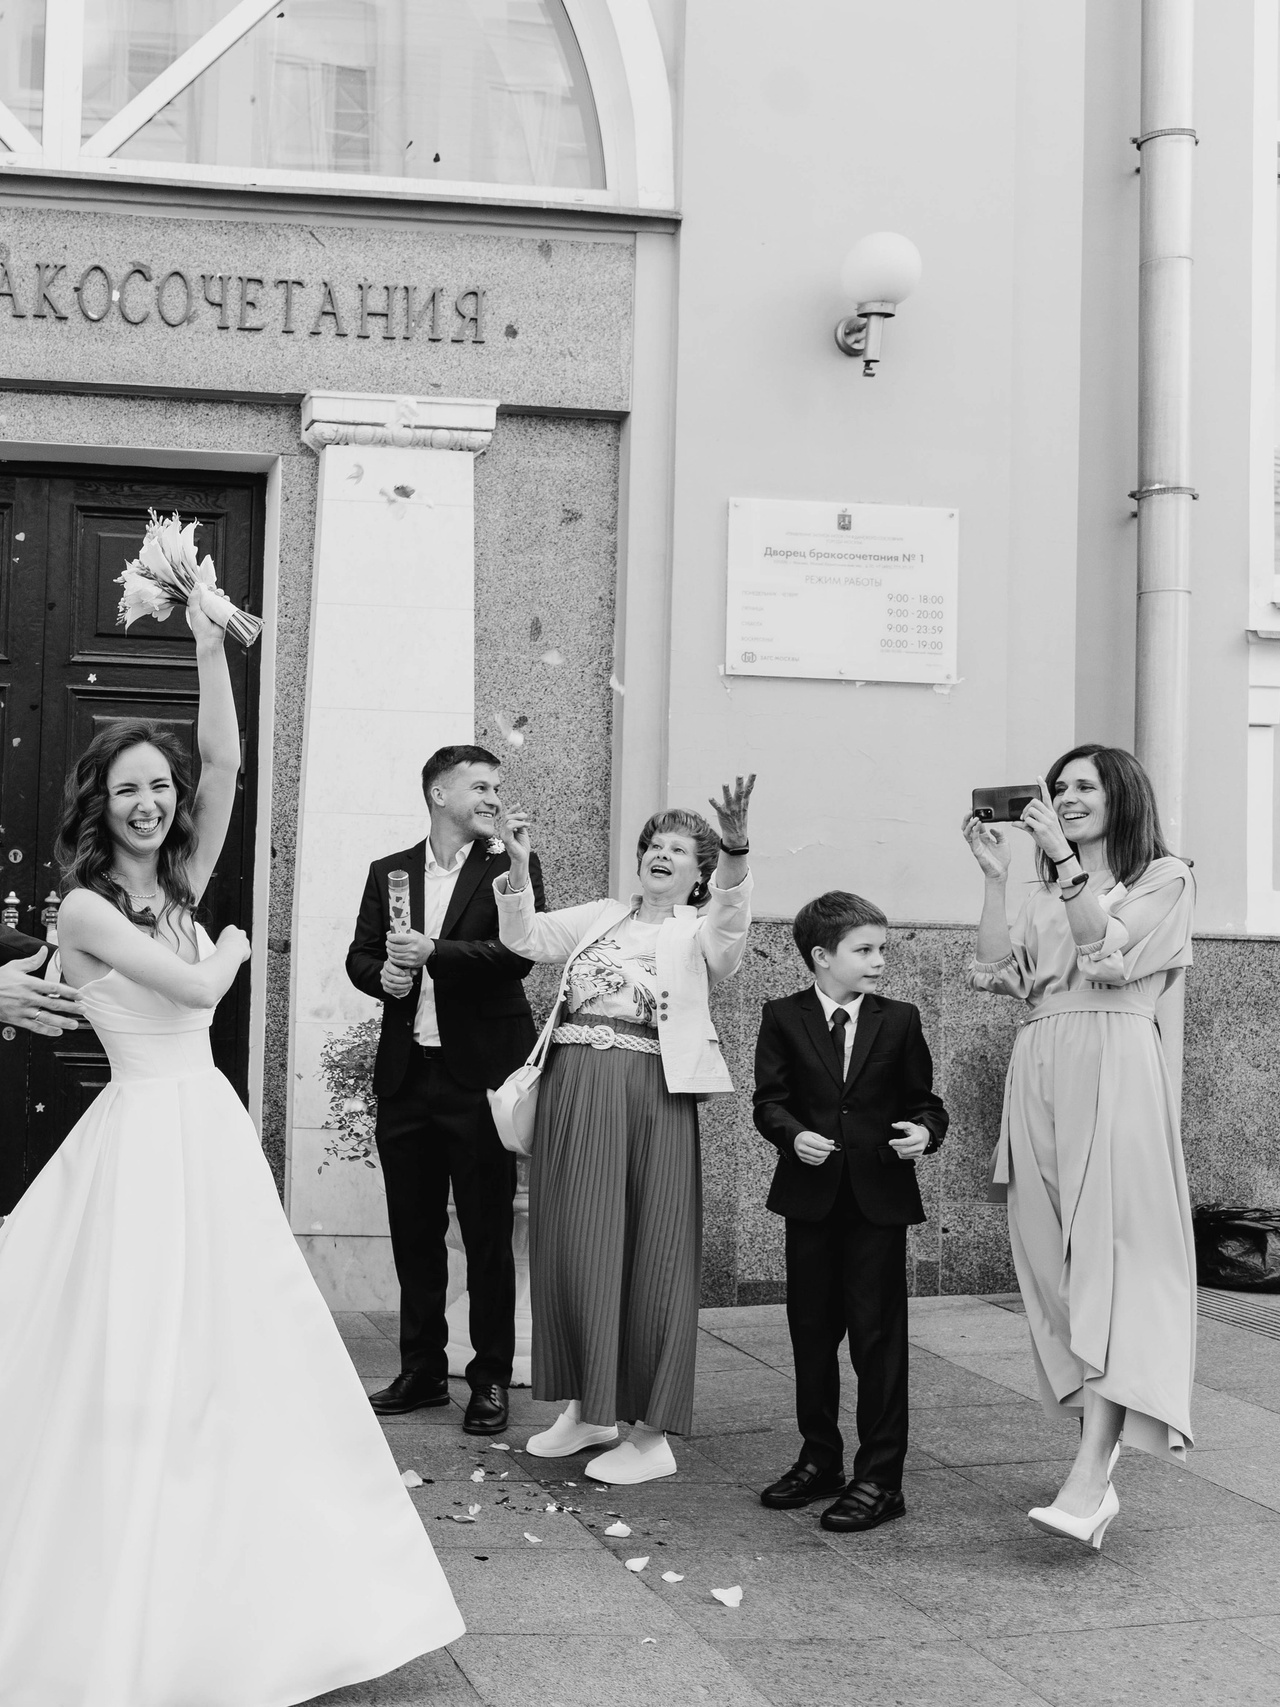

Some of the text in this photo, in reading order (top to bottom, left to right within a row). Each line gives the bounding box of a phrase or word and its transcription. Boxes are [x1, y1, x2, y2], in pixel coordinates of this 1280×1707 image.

[763, 547, 924, 563] Дворец бракосочетания № 1
[805, 575, 882, 587] РЕЖИМ РАБОТЫ
[887, 593, 908, 603] 9:00
[919, 594, 943, 604] 18:00
[887, 608, 908, 618] 9:00
[916, 609, 943, 619] 20:00
[887, 623, 908, 633] 9:00
[916, 624, 943, 635] 23:59
[880, 638, 908, 648] 00:00
[917, 640, 943, 650] 19:00
